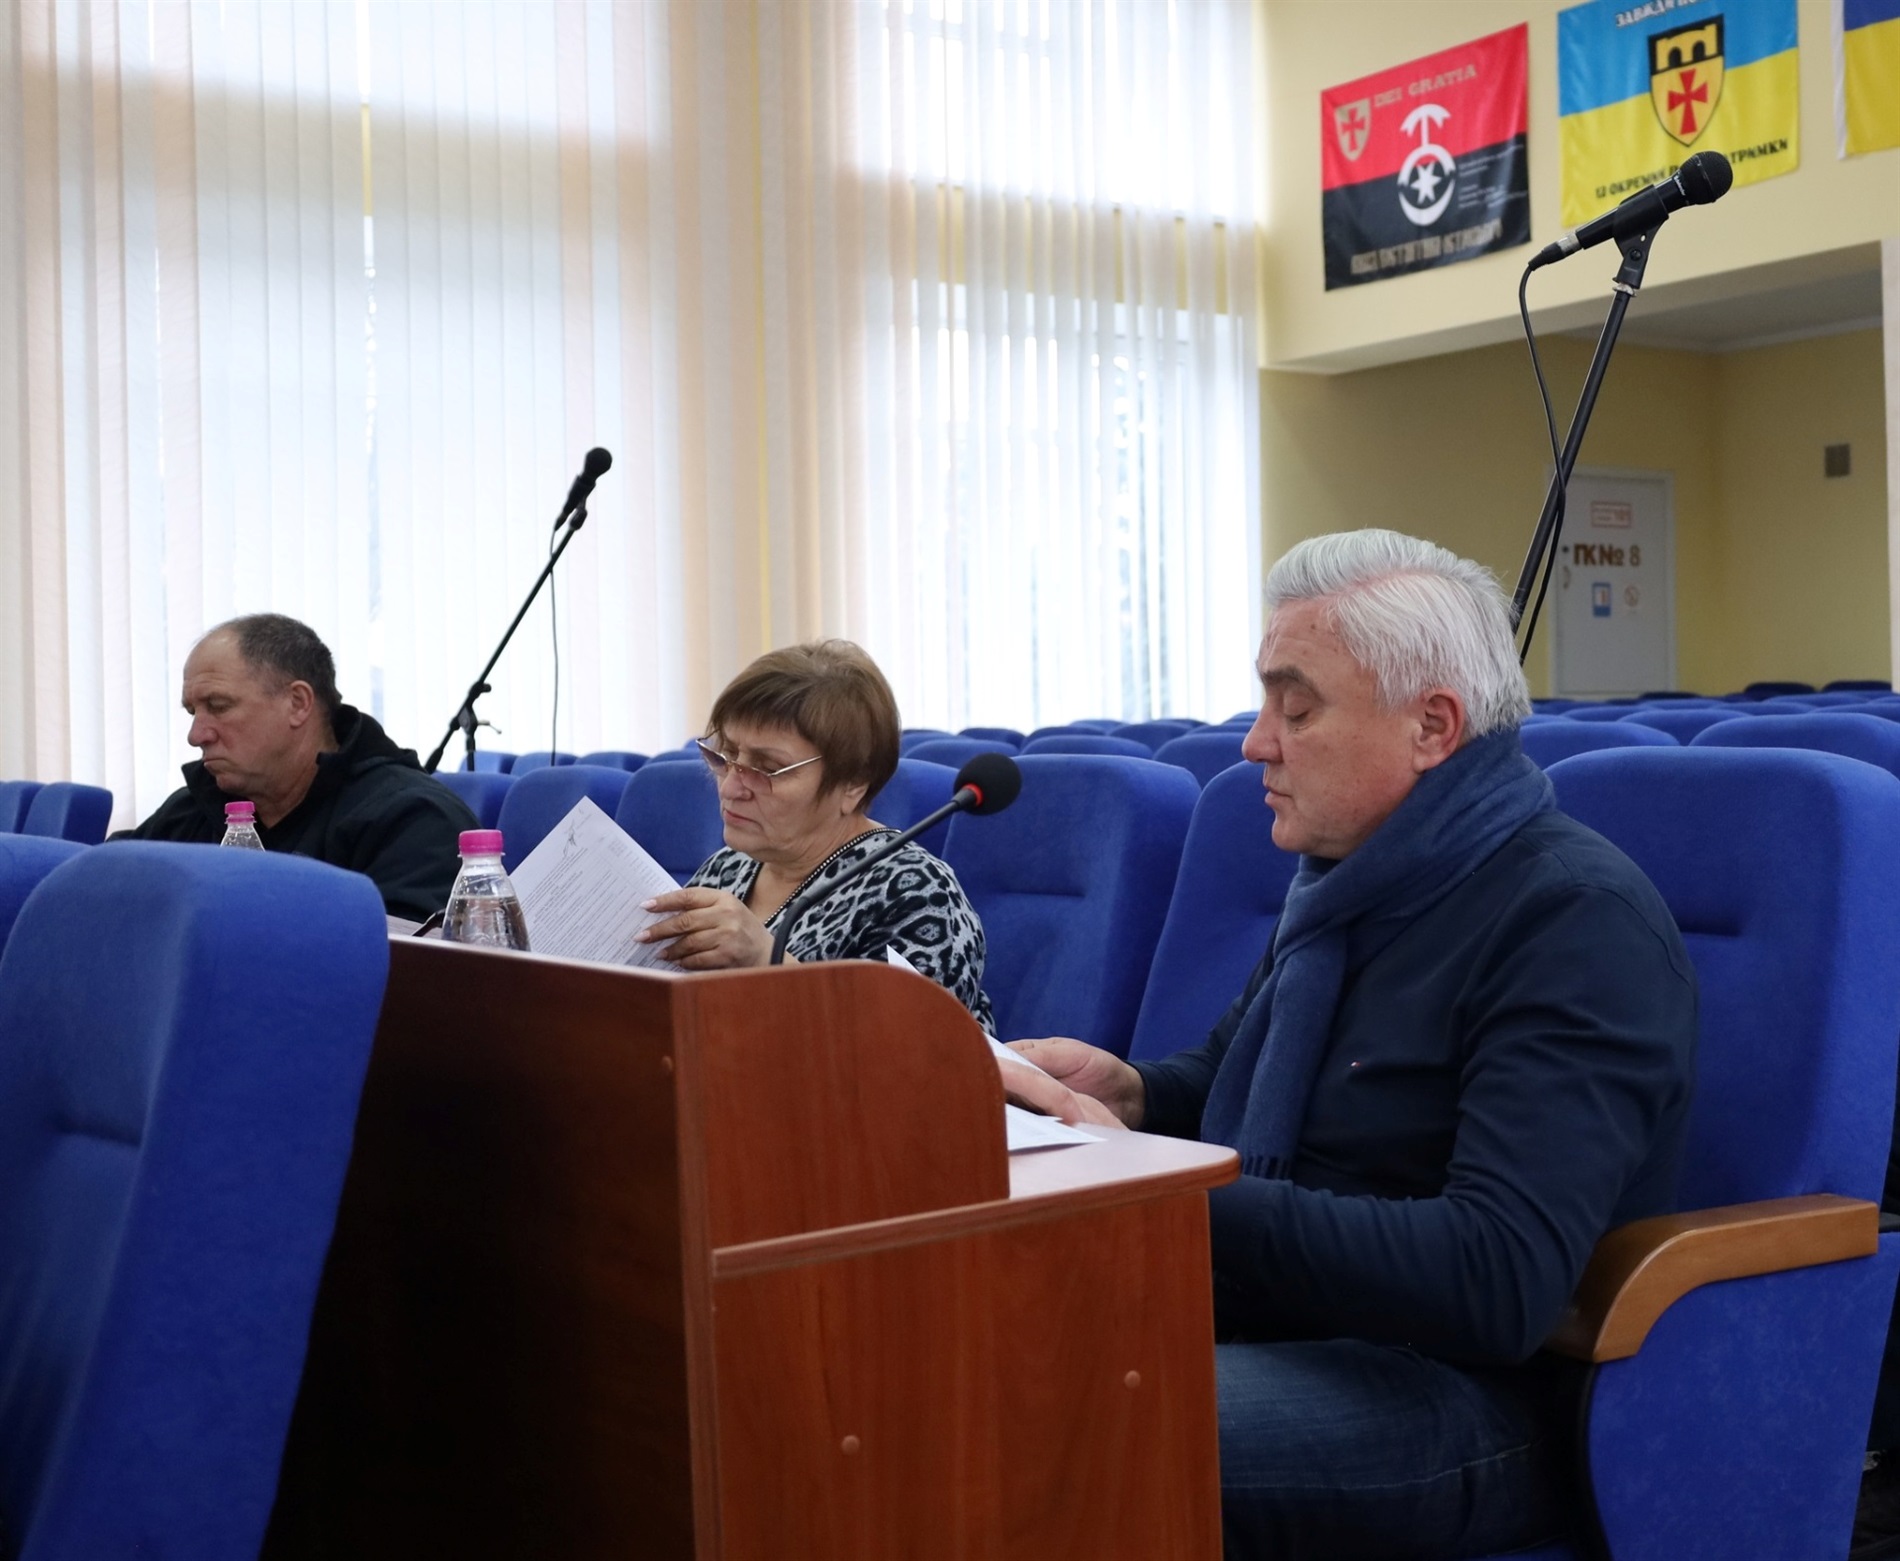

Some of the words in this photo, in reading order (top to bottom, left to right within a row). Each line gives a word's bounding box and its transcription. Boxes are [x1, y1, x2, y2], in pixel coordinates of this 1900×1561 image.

[1408, 64, 1476, 97] GRATIA
[1727, 138, 1788, 164] ТРИМКИ
[1629, 544, 1641, 567] 8
